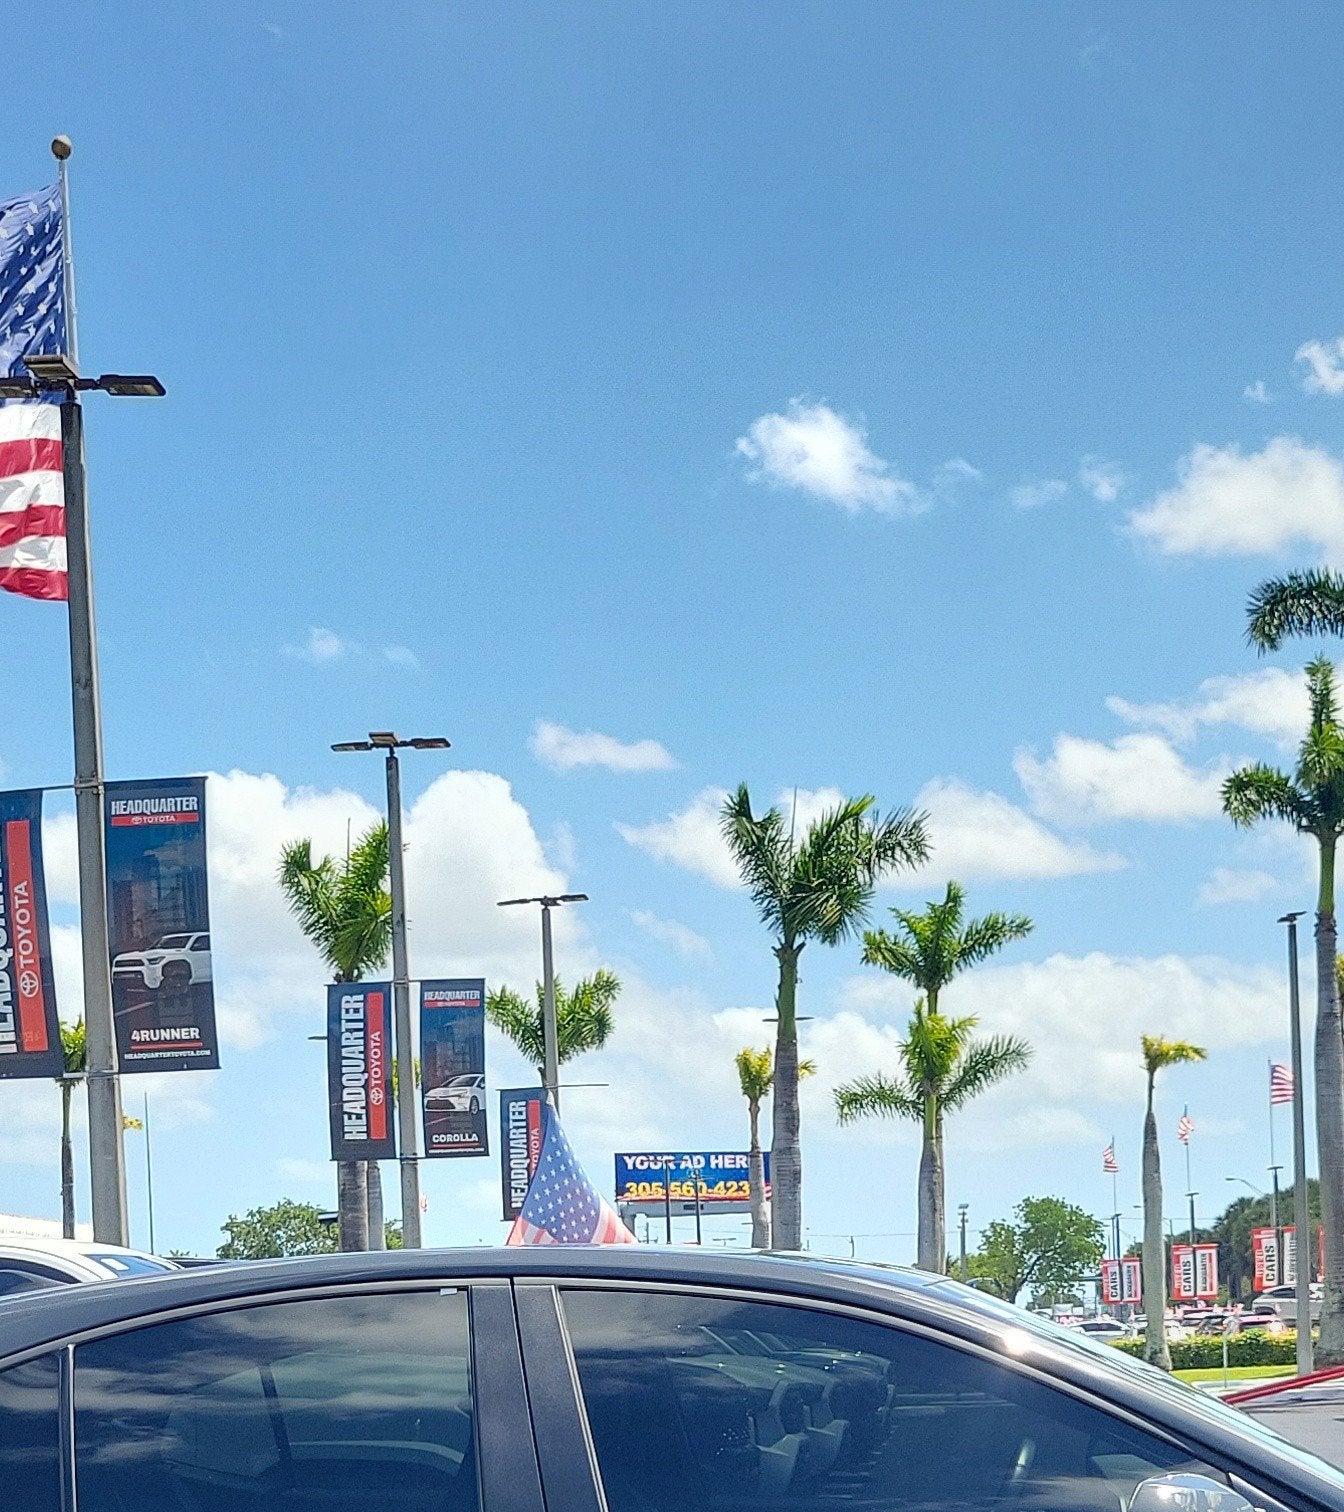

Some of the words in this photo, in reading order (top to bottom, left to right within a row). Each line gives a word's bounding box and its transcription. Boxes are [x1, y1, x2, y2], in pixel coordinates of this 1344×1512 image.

[111, 797, 198, 815] HEADQUARTER
[143, 815, 176, 824] TOYOTA
[13, 880, 35, 969] TOYOTA
[424, 990, 481, 1002] HEADQUARTER
[131, 1027, 200, 1042] 4RUNNER
[340, 994, 368, 1140] HEADQUARTER
[371, 1031, 382, 1087] TOYOTA
[432, 1132, 479, 1144] COROLLA
[509, 1100, 530, 1209] HEADQUARTER
[623, 1155, 677, 1171] YOUR
[680, 1155, 706, 1170] AD
[709, 1155, 750, 1170] HER
[1265, 1244, 1275, 1282] CARS
[1182, 1260, 1192, 1292] CARS
